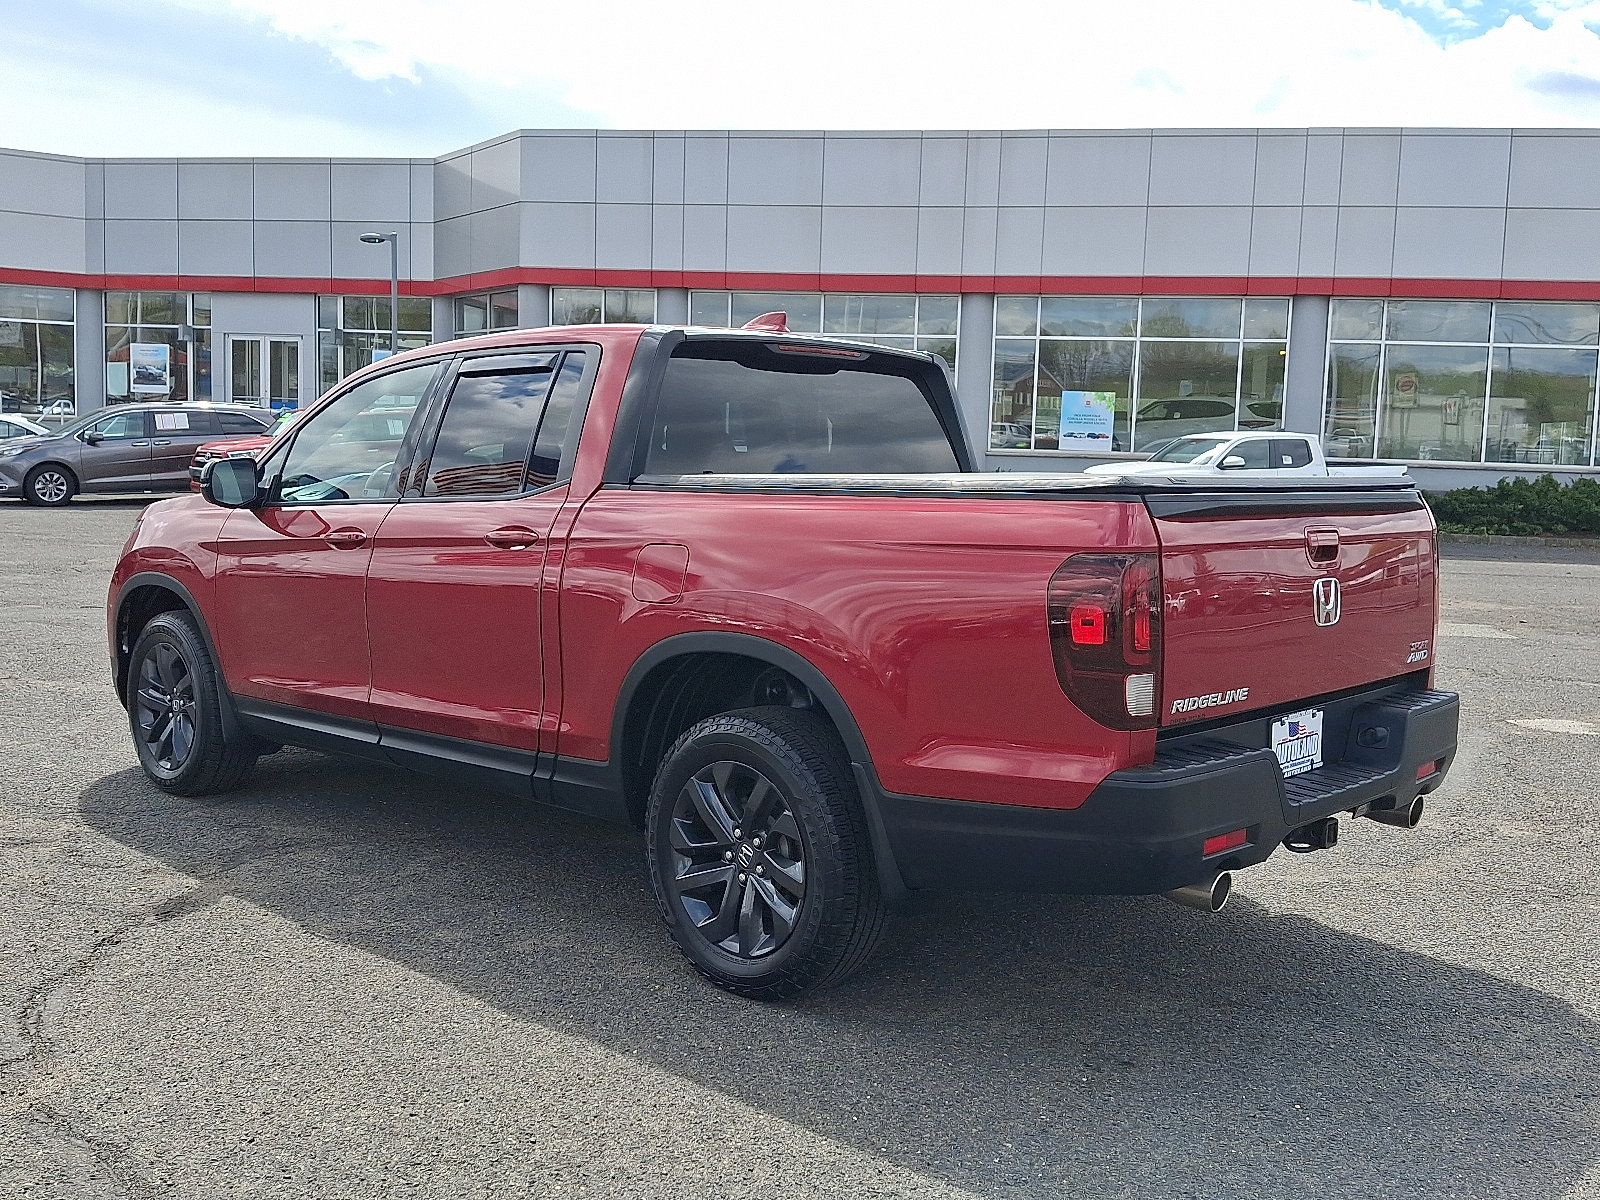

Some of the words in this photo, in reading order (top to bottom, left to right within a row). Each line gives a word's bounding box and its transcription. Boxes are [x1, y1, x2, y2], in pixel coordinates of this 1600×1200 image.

[1406, 650, 1429, 664] AWD
[1170, 687, 1250, 715] RIDGELINE
[1276, 733, 1319, 765] AUTOLAND
